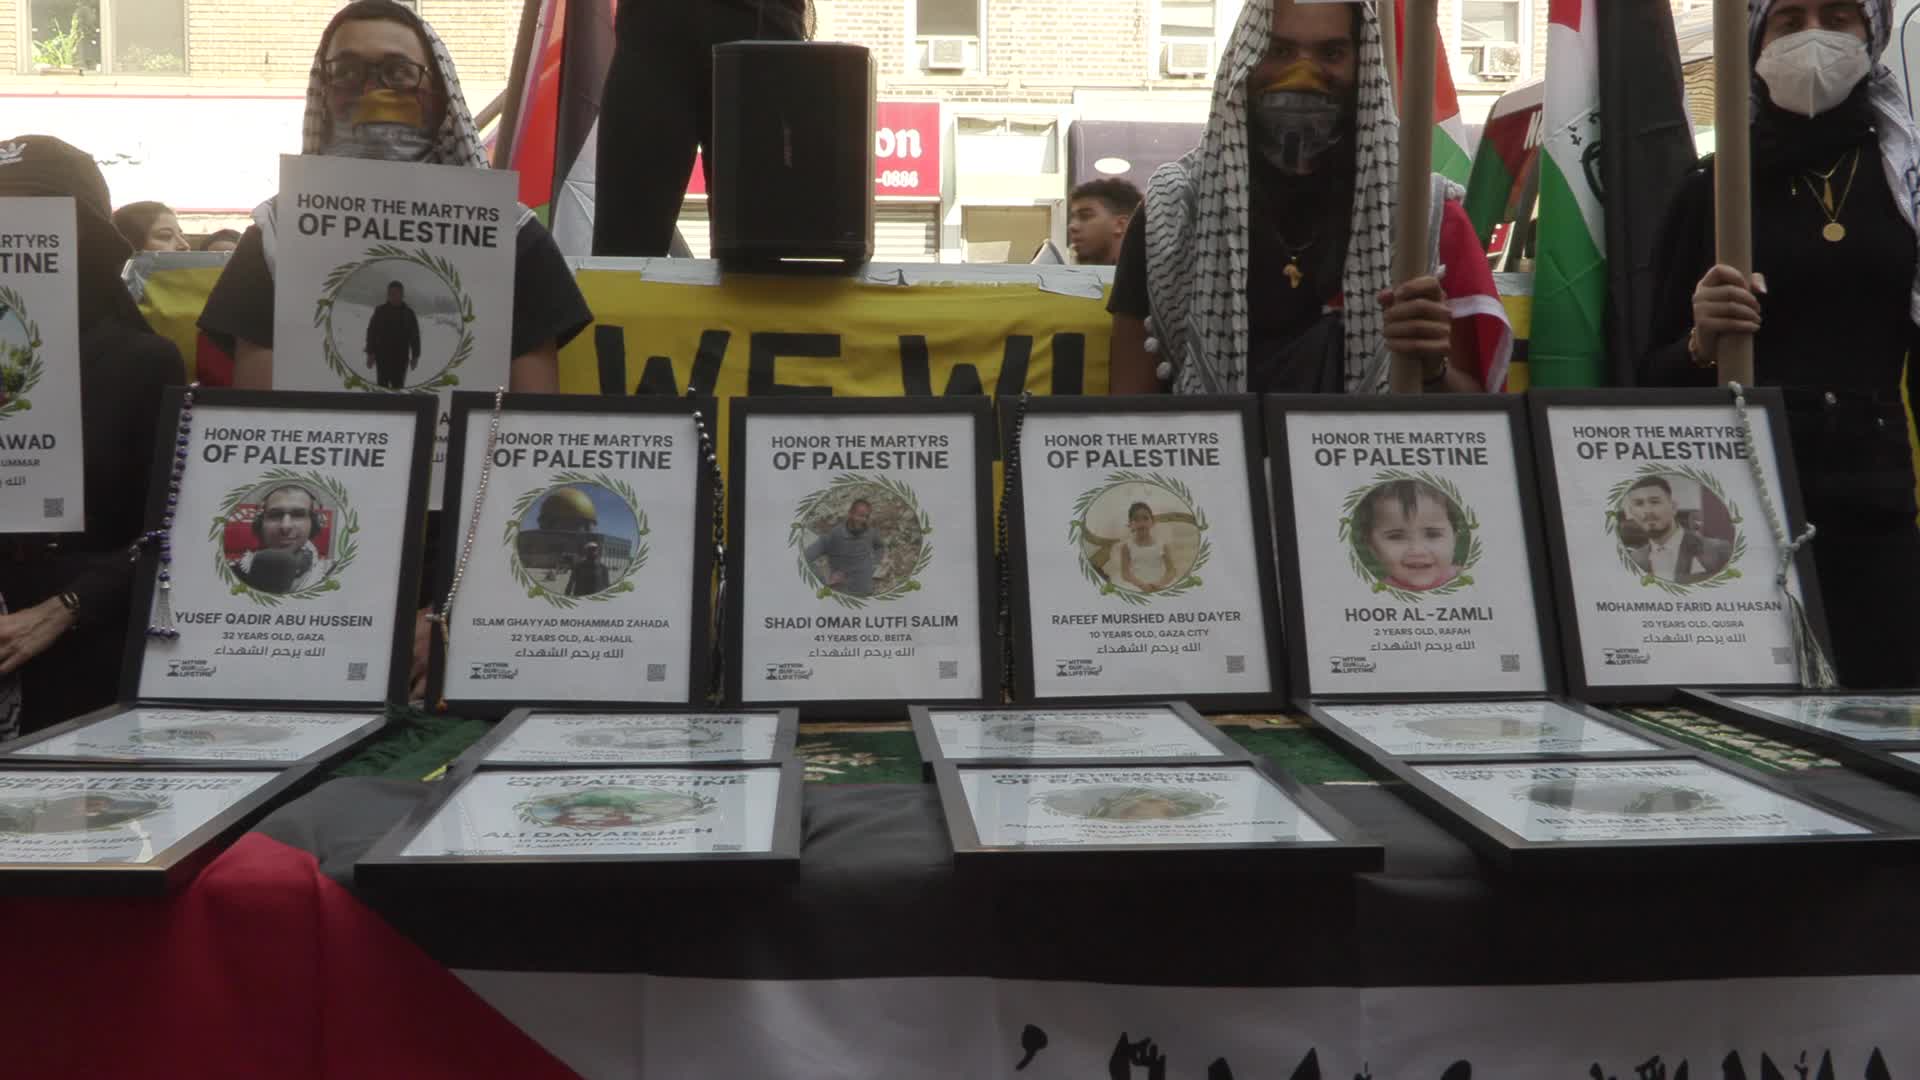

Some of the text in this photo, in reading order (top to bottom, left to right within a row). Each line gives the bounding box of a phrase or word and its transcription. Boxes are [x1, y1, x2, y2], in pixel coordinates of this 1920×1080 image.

[297, 193, 500, 222] HONOR THE MARTYRS
[298, 213, 498, 248] OF PALESTINE
[0, 234, 60, 248] RTYRS
[0, 252, 59, 273] TINE
[204, 427, 389, 445] HONOR THE MARTYRS
[1312, 432, 1487, 445] HONOR THE MARTYRS
[1573, 426, 1745, 439] HONOR THE MARTYRS
[495, 433, 673, 448] HONOR THE MARTYRS
[772, 435, 949, 448] HONOR THE MARTYRS
[1044, 432, 1219, 447] HONOR THE MARTYRS
[203, 444, 386, 467] OF PALESTINE
[1314, 447, 1489, 466] OF PALESTINE
[1576, 441, 1749, 460] OF PALESTINE
[492, 448, 672, 470] OF PALESTINE
[773, 451, 949, 470] OF PALESTINE
[1047, 448, 1220, 469] OF PALESTINE
[1596, 601, 1673, 612] MOHAMMAD
[1676, 601, 1712, 612] FARID
[175, 611, 373, 627] YUSEF QADIR ABU HUSSEIN
[1052, 611, 1241, 625] RAFEEF MURSHED ABU DAYER
[1345, 607, 1493, 622] HOOR AL-ZAMLI
[472, 617, 505, 627] ISLAM
[507, 617, 558, 628] GHAYYAD
[560, 618, 625, 628] MOHAMMAD
[764, 615, 958, 629] SHADI OMAR LUTFI SALIM
[1656, 620, 1686, 628] YEARS
[237, 632, 269, 641] YEARS
[524, 634, 556, 643] YEARS
[827, 634, 858, 642] YEARS
[1103, 631, 1133, 639] YEARS
[1158, 630, 1186, 638] GAZA
[1382, 628, 1413, 636] YEARS
[1642, 633, 1747, 645] الله يرحم الشهداء
[214, 645, 326, 658] الله يرحم الشهداء
[808, 647, 915, 659] الله يرحم الشهداء
[1096, 643, 1201, 655] الله يرحم الشهداء
[1370, 641, 1475, 652] الله يرحم الشهداء
[514, 647, 624, 660] الله يرحم الشهداء
